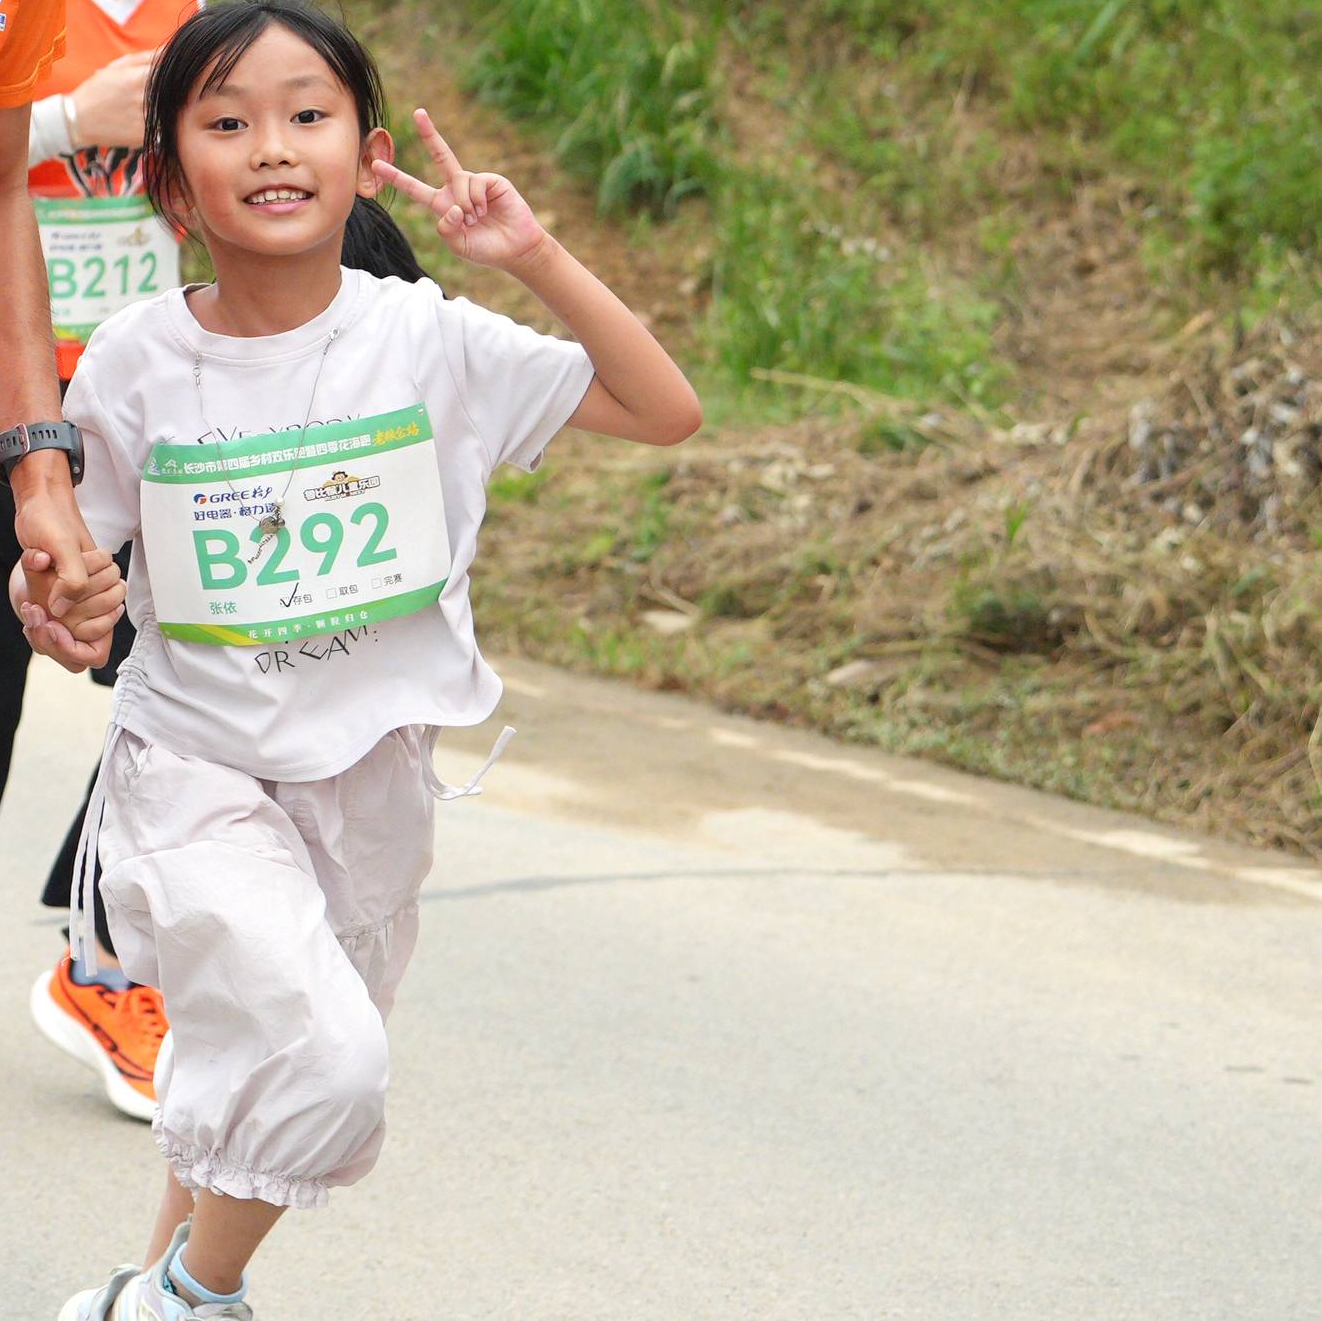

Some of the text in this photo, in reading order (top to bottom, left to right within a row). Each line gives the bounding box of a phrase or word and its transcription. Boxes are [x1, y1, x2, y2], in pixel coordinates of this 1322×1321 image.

[47, 250, 158, 299] B212
[209, 489, 250, 504] GREE
[192, 501, 398, 591] B292
[292, 593, 313, 606] 存包
[338, 584, 359, 596] 取包
[383, 573, 403, 586] 完赛
